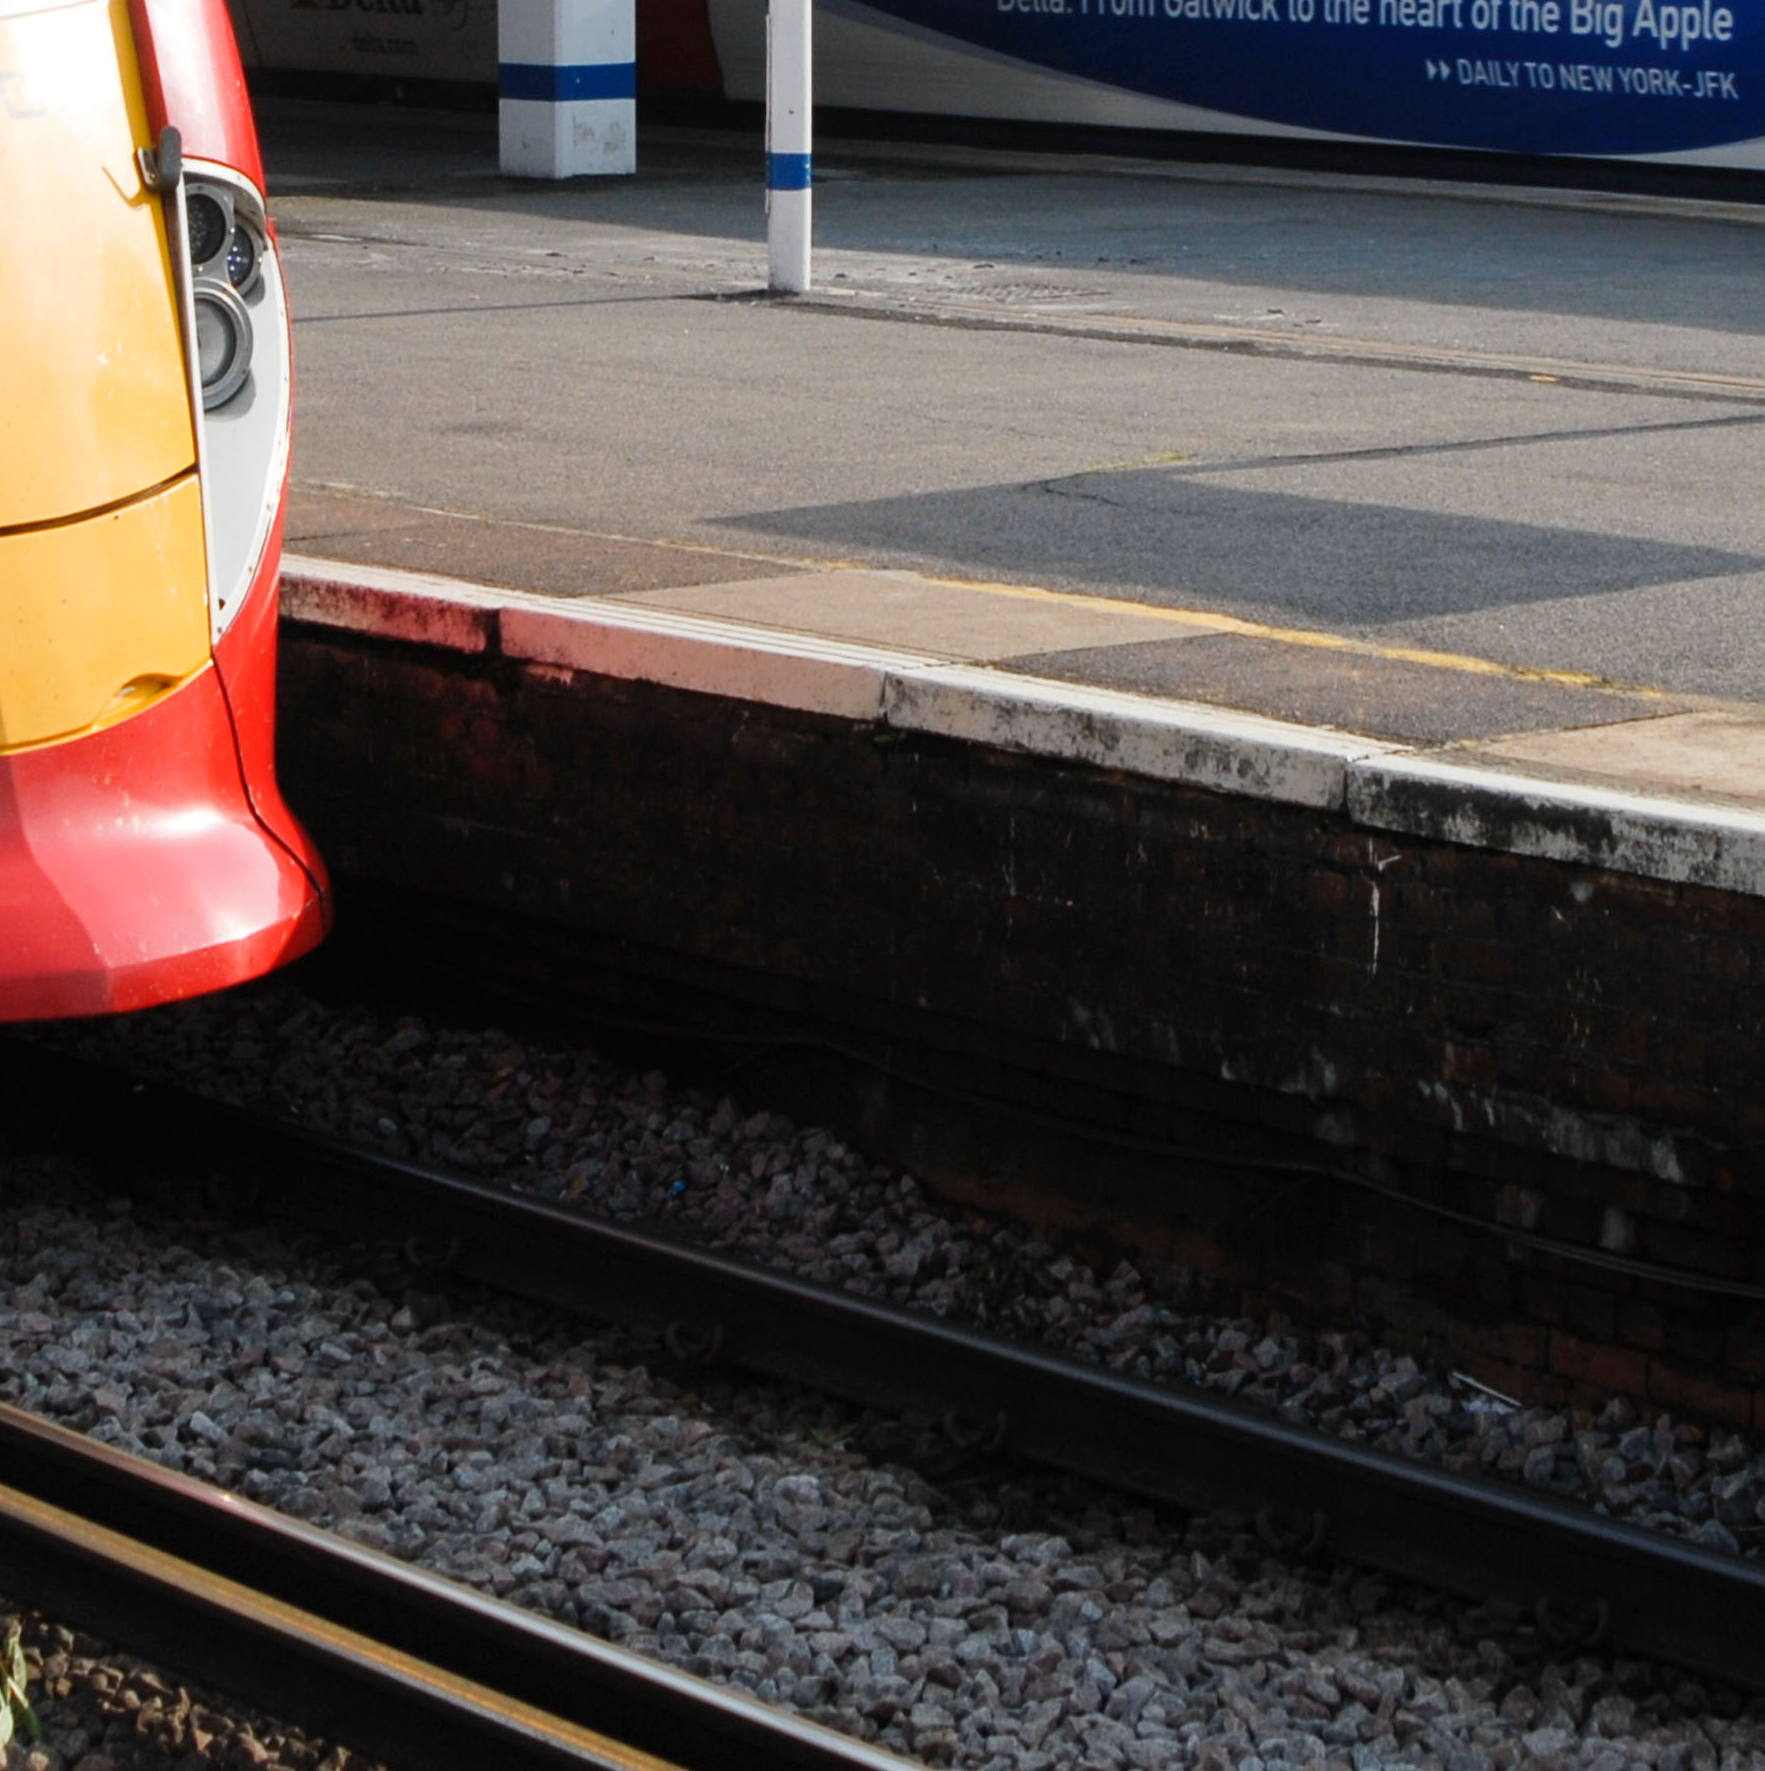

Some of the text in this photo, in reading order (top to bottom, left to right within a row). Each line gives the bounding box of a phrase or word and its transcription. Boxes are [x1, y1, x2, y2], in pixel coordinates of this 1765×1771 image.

[1456, 58, 1740, 101] DAILY TO NEW YORK-JFK
